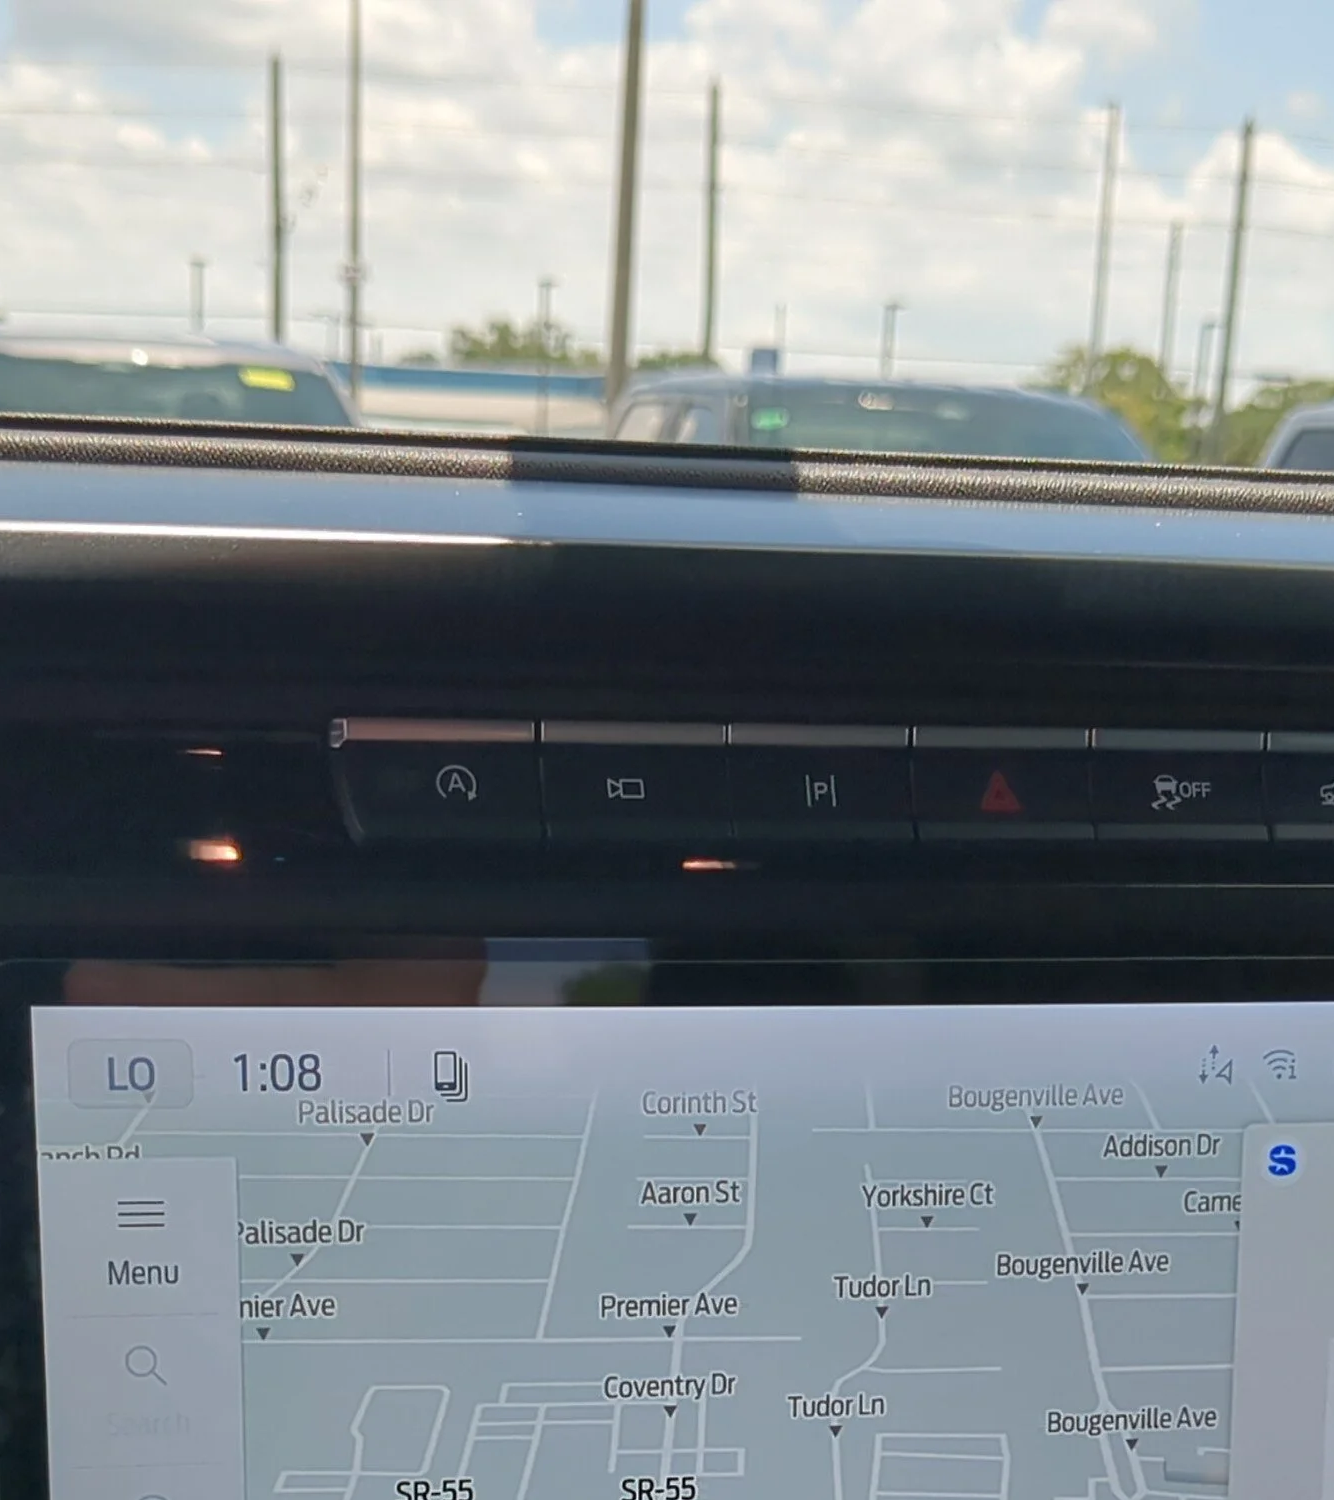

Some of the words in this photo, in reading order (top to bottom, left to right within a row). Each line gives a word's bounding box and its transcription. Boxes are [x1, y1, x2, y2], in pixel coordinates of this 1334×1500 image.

[1179, 781, 1212, 800] OFF
[108, 1057, 156, 1091] LO
[234, 1053, 322, 1093] 1:08
[642, 1090, 725, 1116] Corinth
[731, 1090, 758, 1114] St
[947, 1084, 1078, 1112] Bougenville
[1083, 1083, 1124, 1107] Ave
[298, 1099, 402, 1125] Palisade
[408, 1099, 435, 1123] Dr
[1103, 1134, 1190, 1159] Addison
[1197, 1133, 1221, 1157] Dr
[641, 1180, 708, 1205] Aaron
[715, 1180, 741, 1204] St
[862, 1183, 964, 1209] Yorkshire
[970, 1183, 994, 1207] Ct
[338, 1220, 365, 1244] Dr
[108, 1260, 180, 1286] Menu
[996, 1252, 1124, 1281] Bougenville
[1129, 1251, 1169, 1275] Ave
[834, 1275, 898, 1300] Tudor
[904, 1275, 931, 1298] Ln
[290, 1294, 336, 1318] Ave
[601, 1293, 688, 1319] Premier
[694, 1292, 738, 1316] Ave
[603, 1374, 706, 1402] Coventry
[711, 1373, 736, 1397] Dr
[788, 1395, 851, 1419] Tudor
[857, 1394, 885, 1417] Ln
[1047, 1408, 1171, 1436] Bougenville
[1176, 1407, 1217, 1431] Ave
